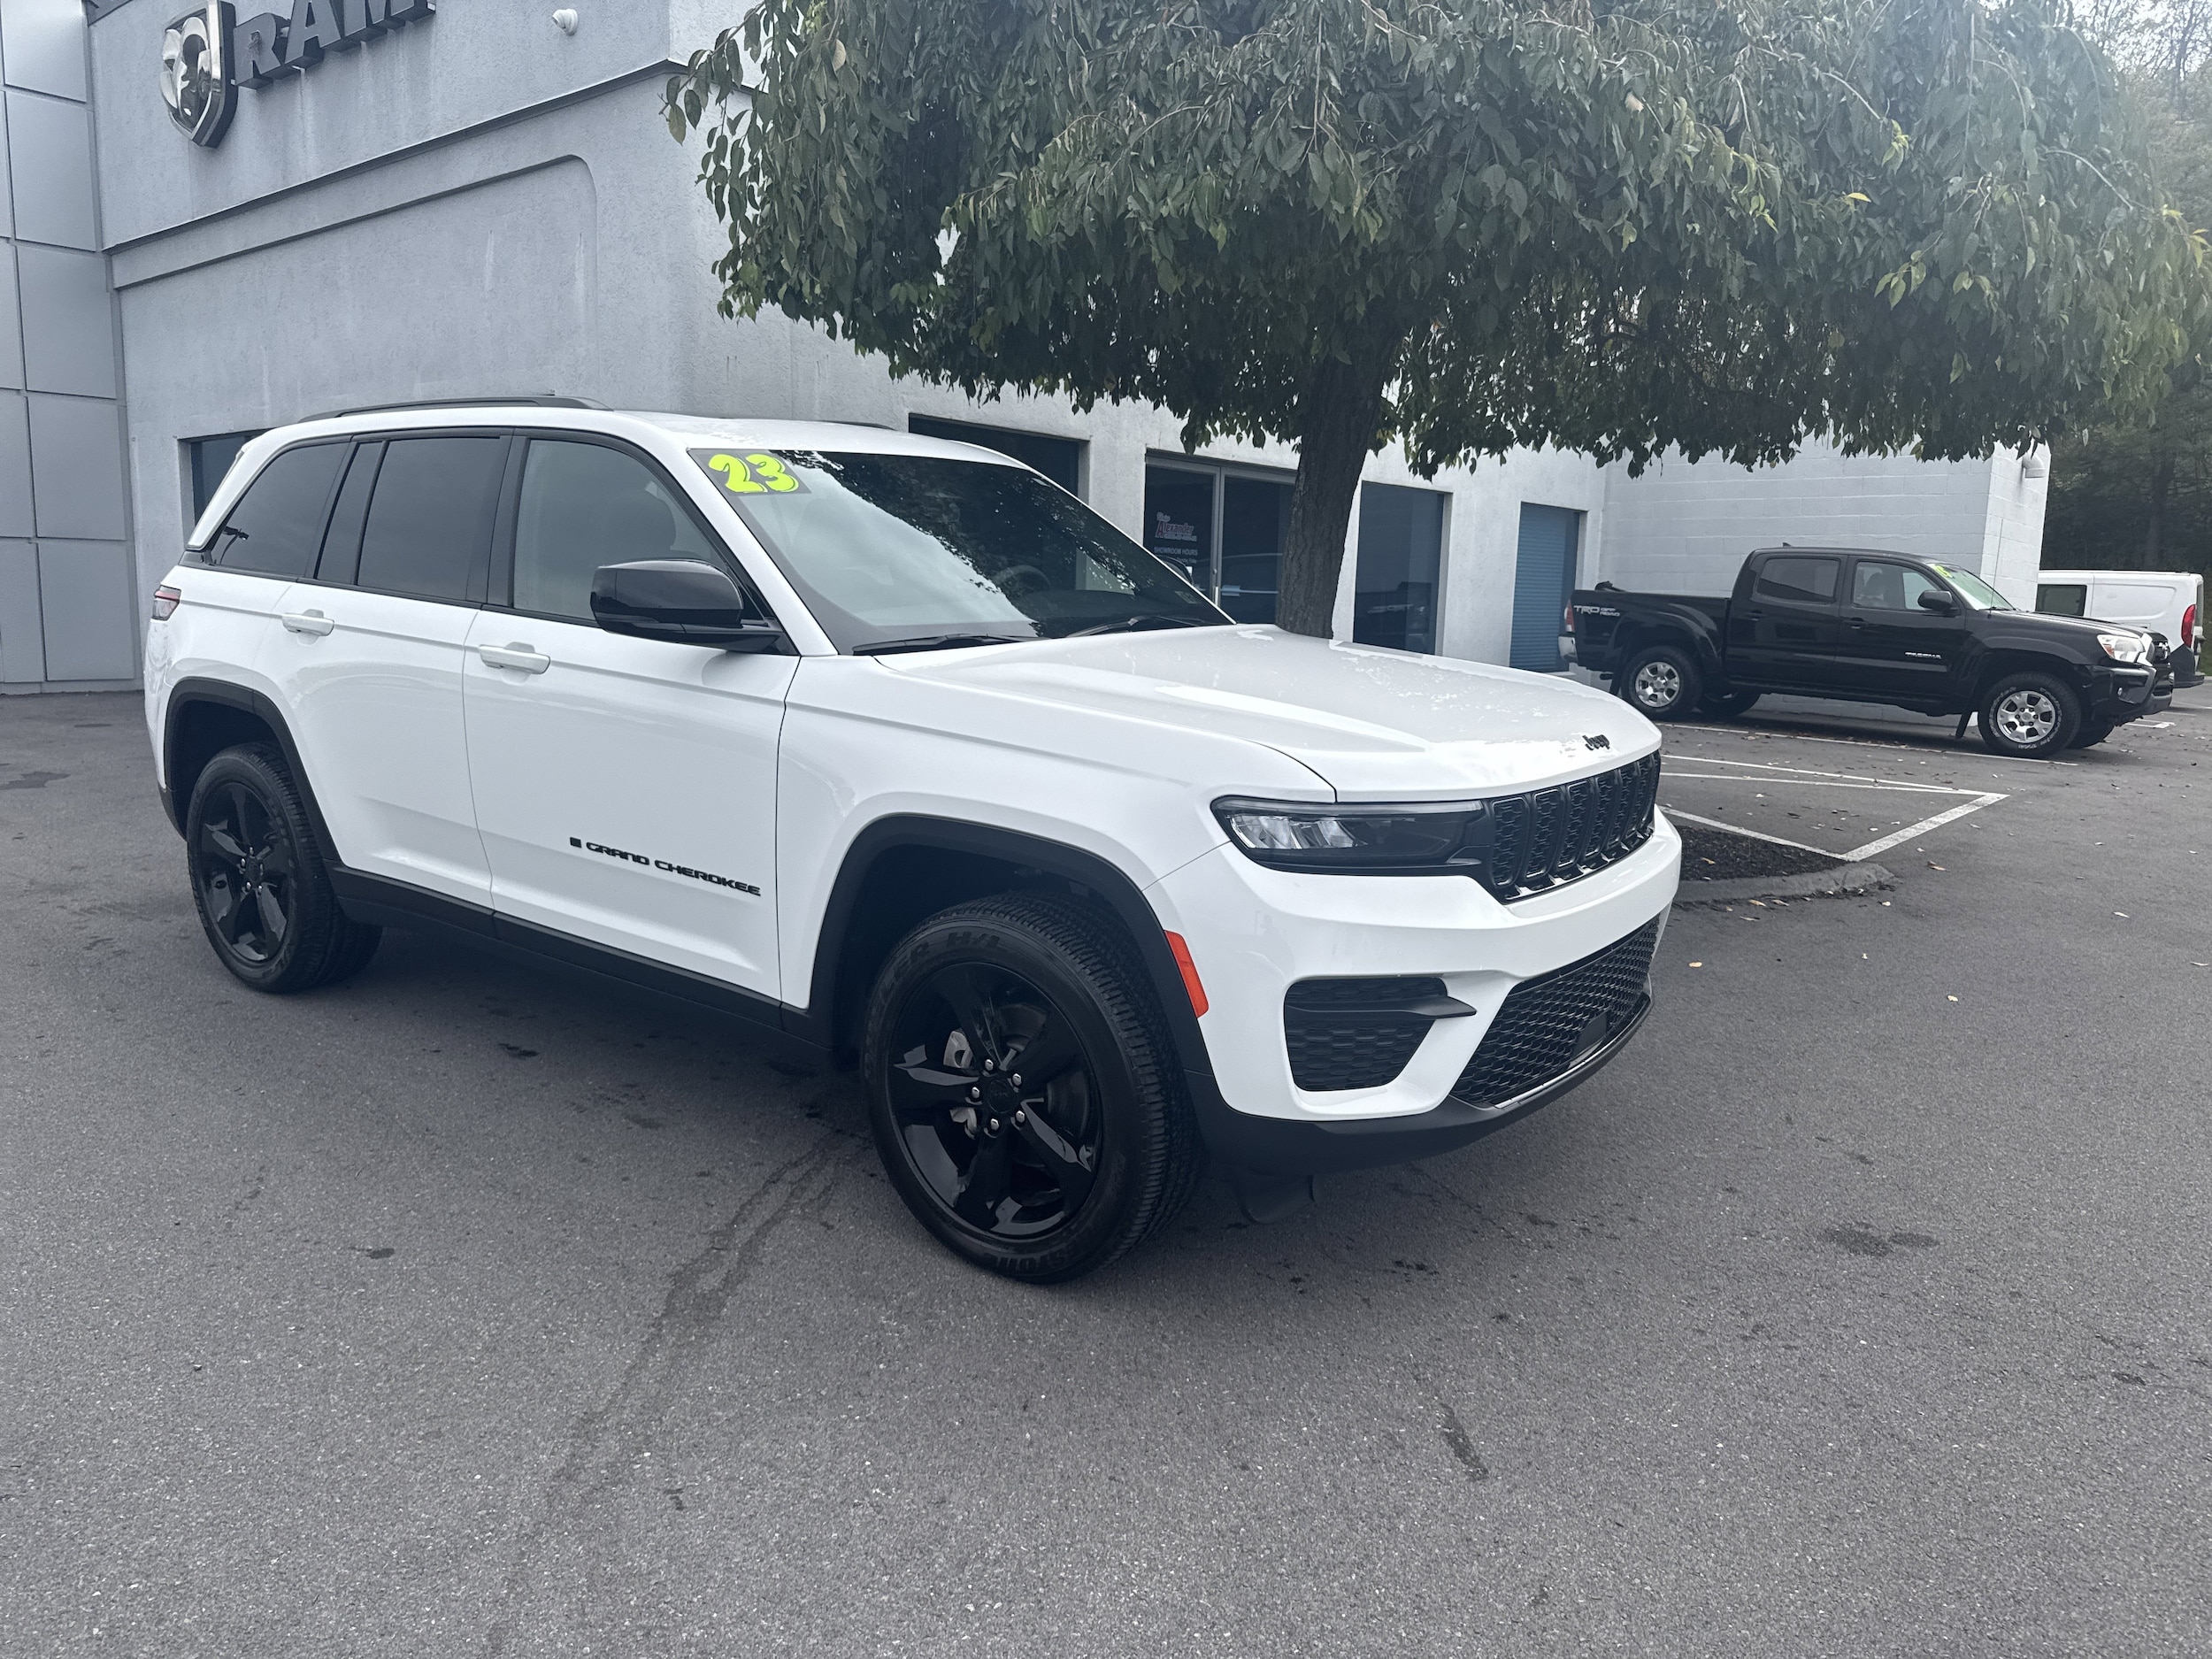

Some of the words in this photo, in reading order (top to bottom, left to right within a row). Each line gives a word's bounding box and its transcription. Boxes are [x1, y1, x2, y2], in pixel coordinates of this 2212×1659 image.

[708, 454, 799, 493] 23
[1155, 521, 1194, 538] Alexander
[1573, 605, 1600, 615] TRD
[586, 841, 649, 865] GRAND
[654, 860, 761, 896] CHEROKEE
